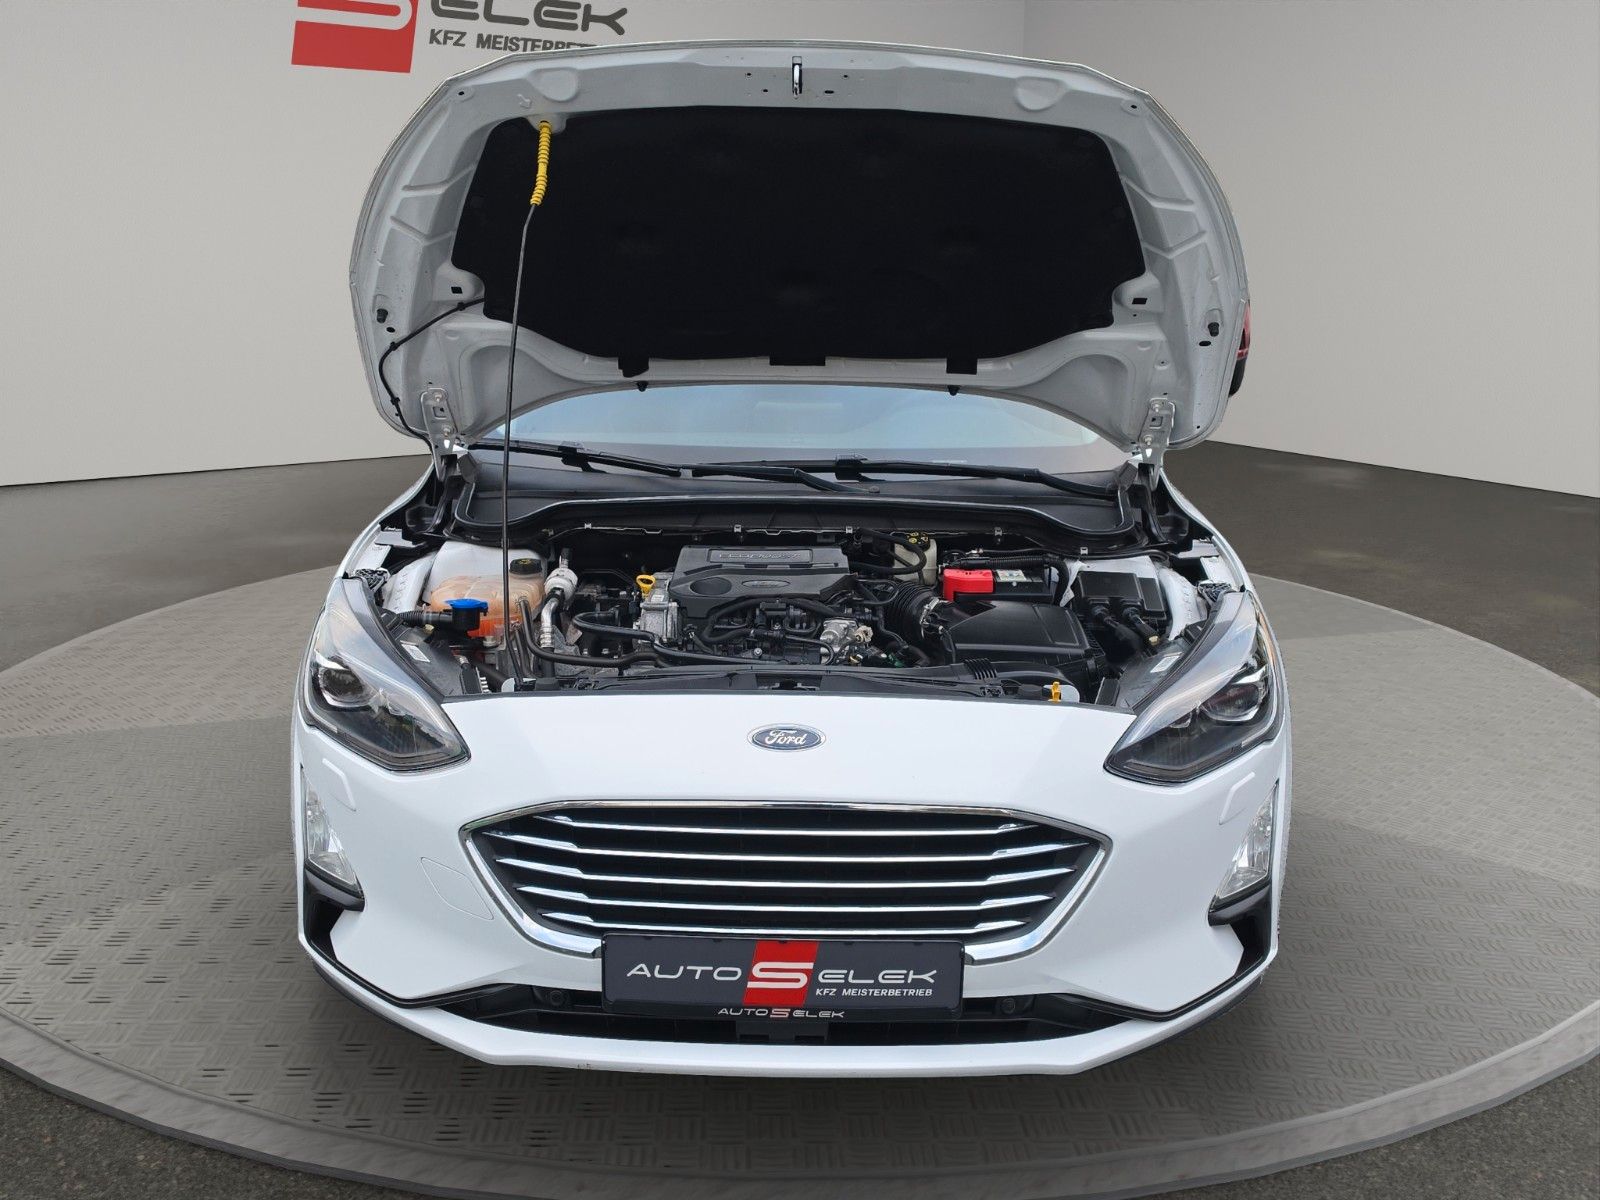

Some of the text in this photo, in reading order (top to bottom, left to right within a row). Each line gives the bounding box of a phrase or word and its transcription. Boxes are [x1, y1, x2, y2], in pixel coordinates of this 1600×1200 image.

[429, 28, 467, 47] KFZ
[764, 729, 808, 745] Ford
[815, 988, 933, 997] KFZ MEISTERBETRIEB
